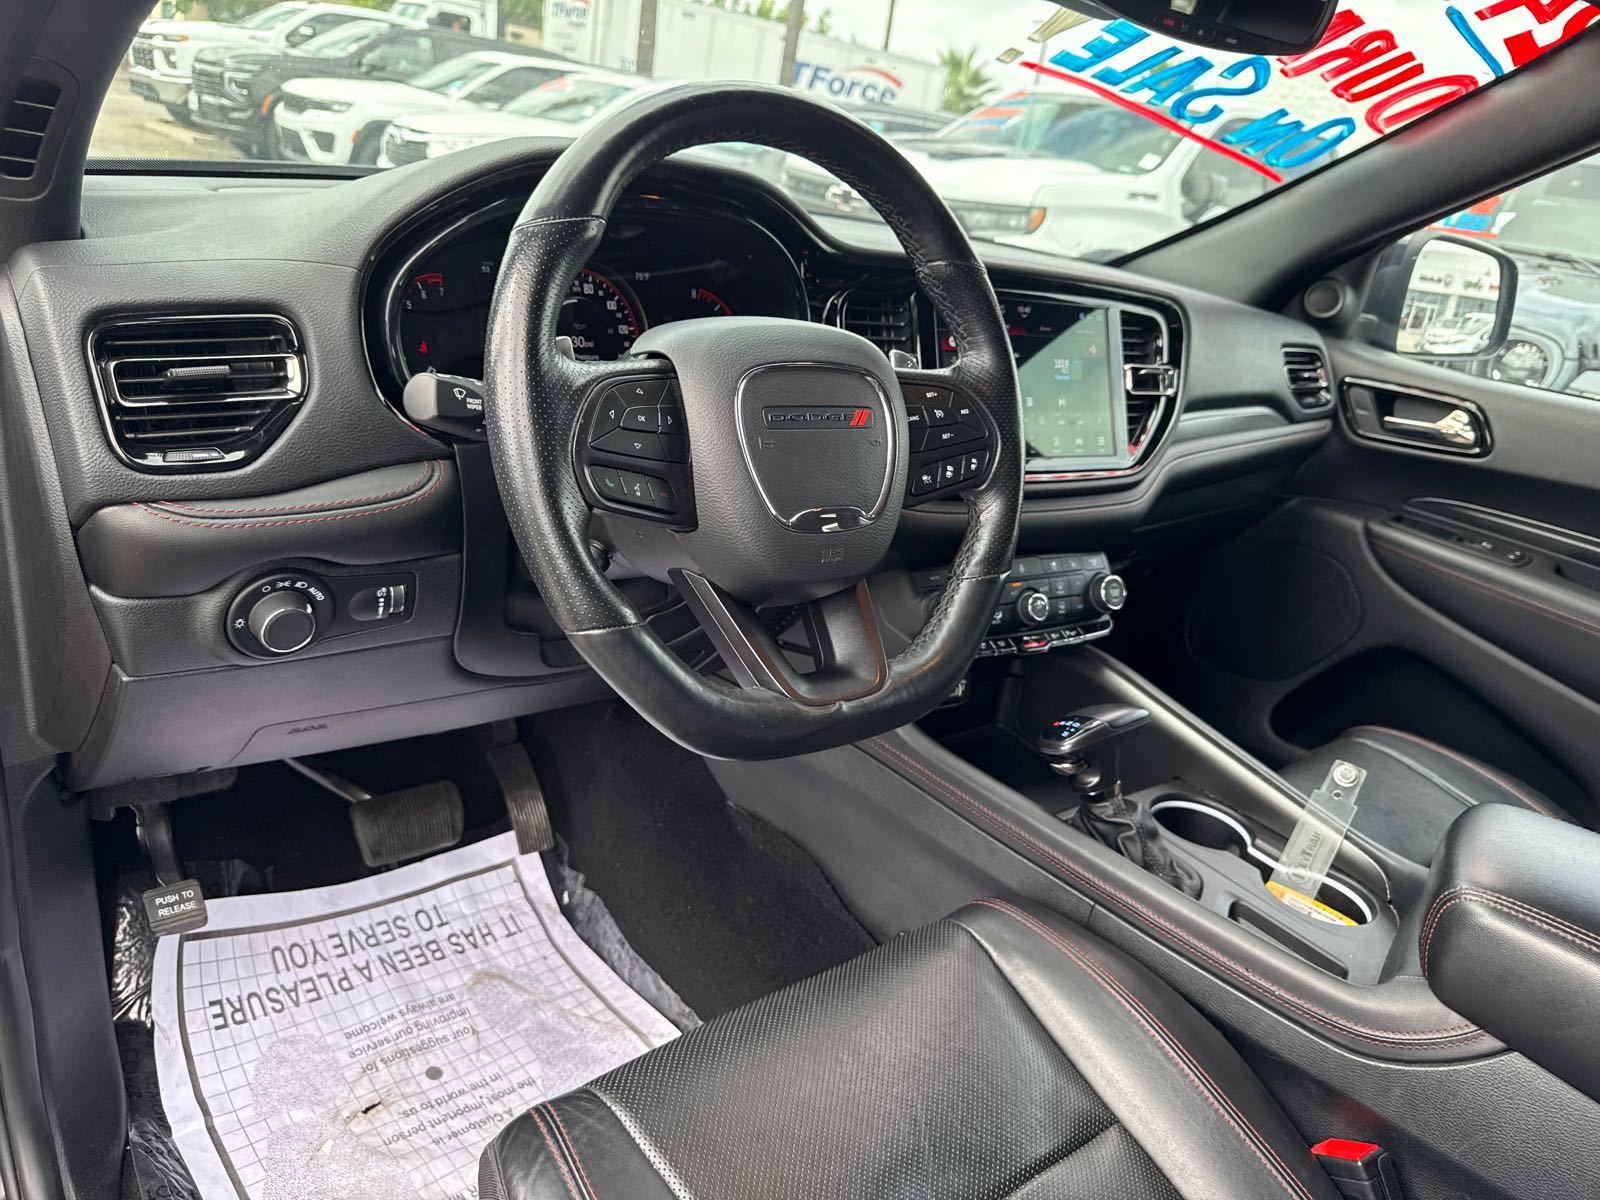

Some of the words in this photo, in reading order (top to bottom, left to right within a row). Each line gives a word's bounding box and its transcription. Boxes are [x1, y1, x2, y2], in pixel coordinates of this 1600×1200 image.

[794, 62, 898, 104] TForce
[420, 290, 427, 299] 6
[583, 284, 594, 295] 80
[406, 301, 412, 310] 5
[637, 414, 646, 423] OK
[768, 412, 855, 423] DODGE
[307, 587, 325, 602] AUTO
[155, 893, 180, 906] PUSH
[181, 890, 195, 899] TO
[158, 900, 198, 917] RELEASE
[414, 904, 449, 932] TO
[500, 913, 523, 938] IT
[328, 915, 411, 958] SERVE
[447, 922, 498, 954] HAS
[271, 939, 328, 974] YOU
[377, 940, 447, 976] BEEN
[353, 959, 374, 983] A
[208, 967, 355, 1031] PLEASURE
[439, 992, 457, 1003] are
[399, 1000, 437, 1018] always
[414, 1006, 471, 1030] improving
[344, 1012, 397, 1040] welcome
[393, 1028, 413, 1041] our
[349, 1034, 392, 1059] service
[380, 1033, 450, 1066] suggestions
[361, 1061, 380, 1074] for
[489, 1072, 504, 1082] in
[470, 1077, 490, 1091] the
[488, 1086, 516, 1101] most
[420, 1100, 435, 1111] to
[437, 1087, 469, 1108] world
[430, 1098, 487, 1126] important
[382, 1121, 427, 1147] person
[449, 1113, 504, 1140] Customer
[432, 1135, 447, 1147] is
